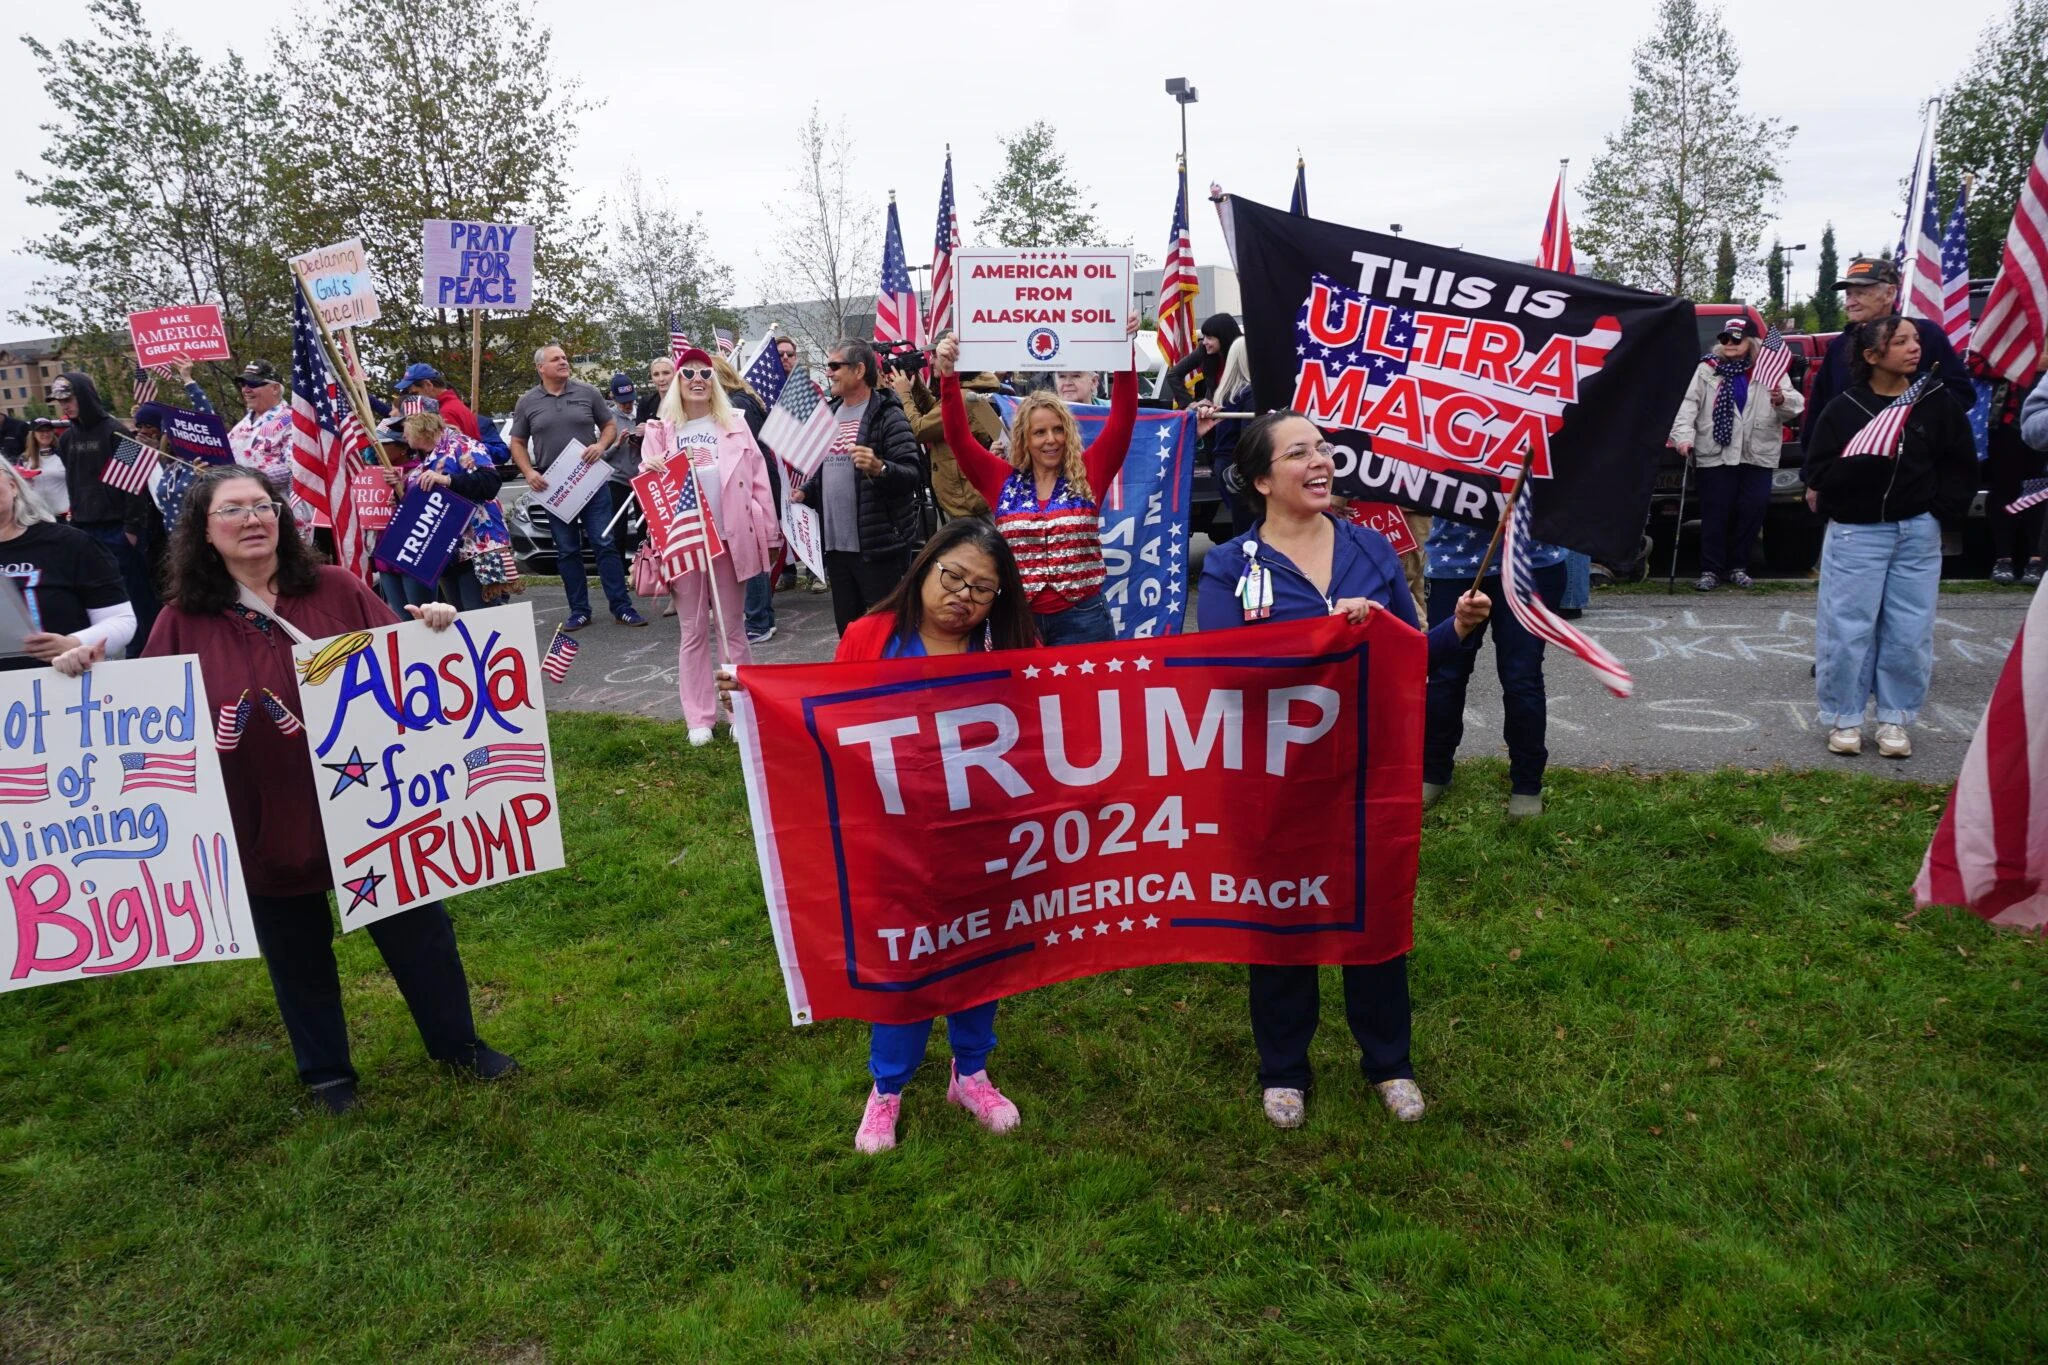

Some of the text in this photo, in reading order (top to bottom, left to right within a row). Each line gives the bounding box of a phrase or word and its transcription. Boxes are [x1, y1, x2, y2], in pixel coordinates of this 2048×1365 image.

[451, 222, 517, 251] PRAY
[298, 250, 358, 275] Declaring
[460, 251, 510, 279] FOR
[971, 264, 1116, 279] AMERICAN OIL
[439, 276, 517, 304] PEACE
[1015, 287, 1073, 301] FROM
[1351, 250, 1572, 319] THIS IS
[159, 315, 191, 325] MAKE
[320, 299, 366, 324] ace!!!
[972, 309, 1116, 323] ALASKAN SOIL
[137, 324, 223, 345] AMERICA
[145, 340, 219, 355] GREAT AGAIN
[1306, 282, 1579, 404] ULTRA
[173, 418, 210, 435] PEACE
[1290, 359, 1554, 480] MAGA
[170, 426, 223, 447] THROUGH
[351, 476, 373, 485] AKE
[546, 485, 565, 505] TRUMP
[567, 461, 586, 481] SUCCE
[1332, 445, 1512, 521] OUNTRY
[353, 488, 395, 503] RICA
[553, 489, 570, 508] BIDEN
[647, 480, 670, 521] GREAT
[359, 506, 392, 516] AGAIN
[396, 492, 444, 564] TRUMP
[0, 661, 196, 755] ot tired
[837, 685, 1340, 816] TRUMP
[57, 752, 97, 808] of
[367, 743, 456, 829] for
[343, 792, 551, 906] TRUMP
[877, 871, 1331, 961] TAKE AMERICA BACK
